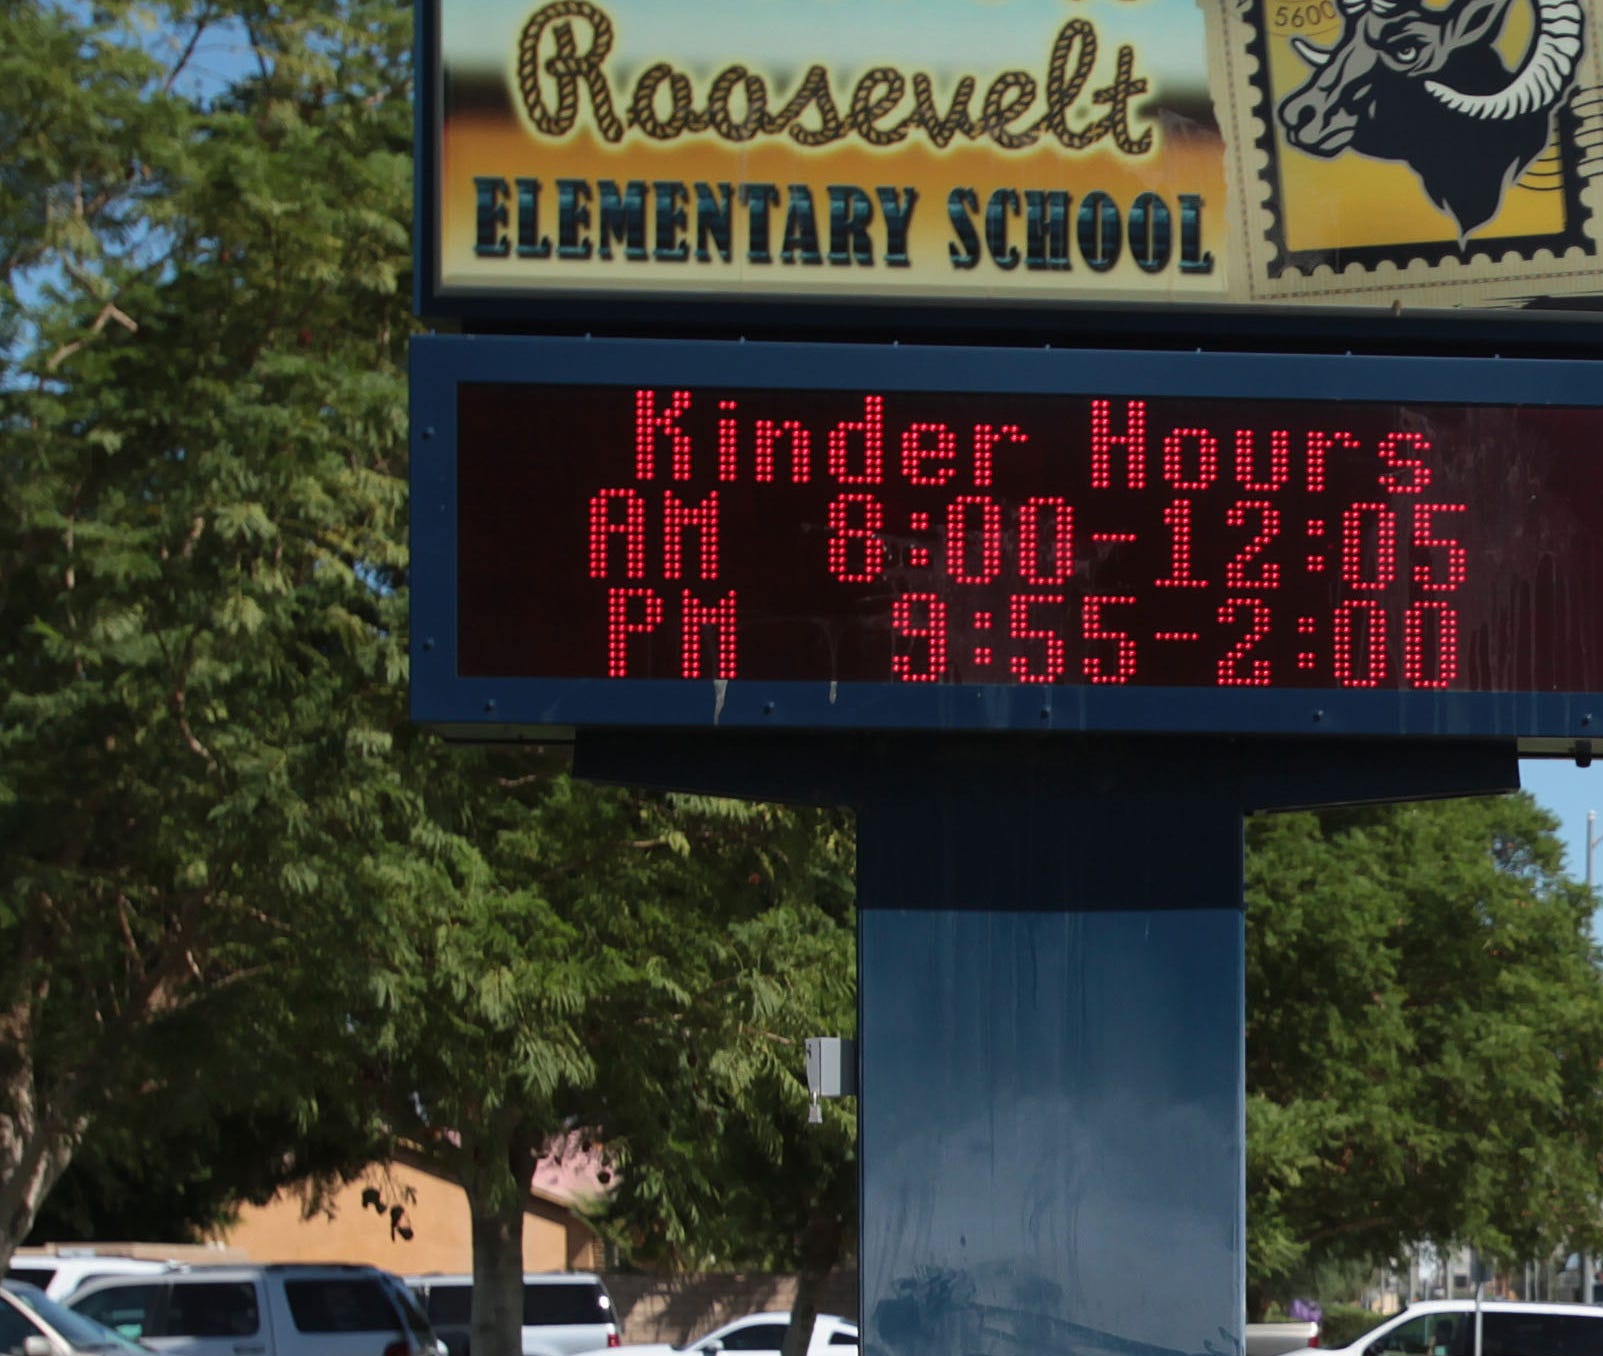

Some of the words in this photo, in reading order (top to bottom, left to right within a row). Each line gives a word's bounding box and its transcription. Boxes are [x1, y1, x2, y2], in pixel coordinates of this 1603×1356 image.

[1274, 0, 1337, 28] 5600
[518, 0, 1153, 155] Roosevelt
[473, 175, 920, 269] ELEMENTARY
[946, 185, 1215, 275] SCHOOL
[634, 390, 1029, 486] Kinder
[1090, 399, 1433, 495] Hours
[588, 488, 719, 580] AM
[828, 493, 1468, 592] 8:00-12:05
[607, 587, 738, 680] PM
[891, 592, 1459, 689] 9:55-2:00
